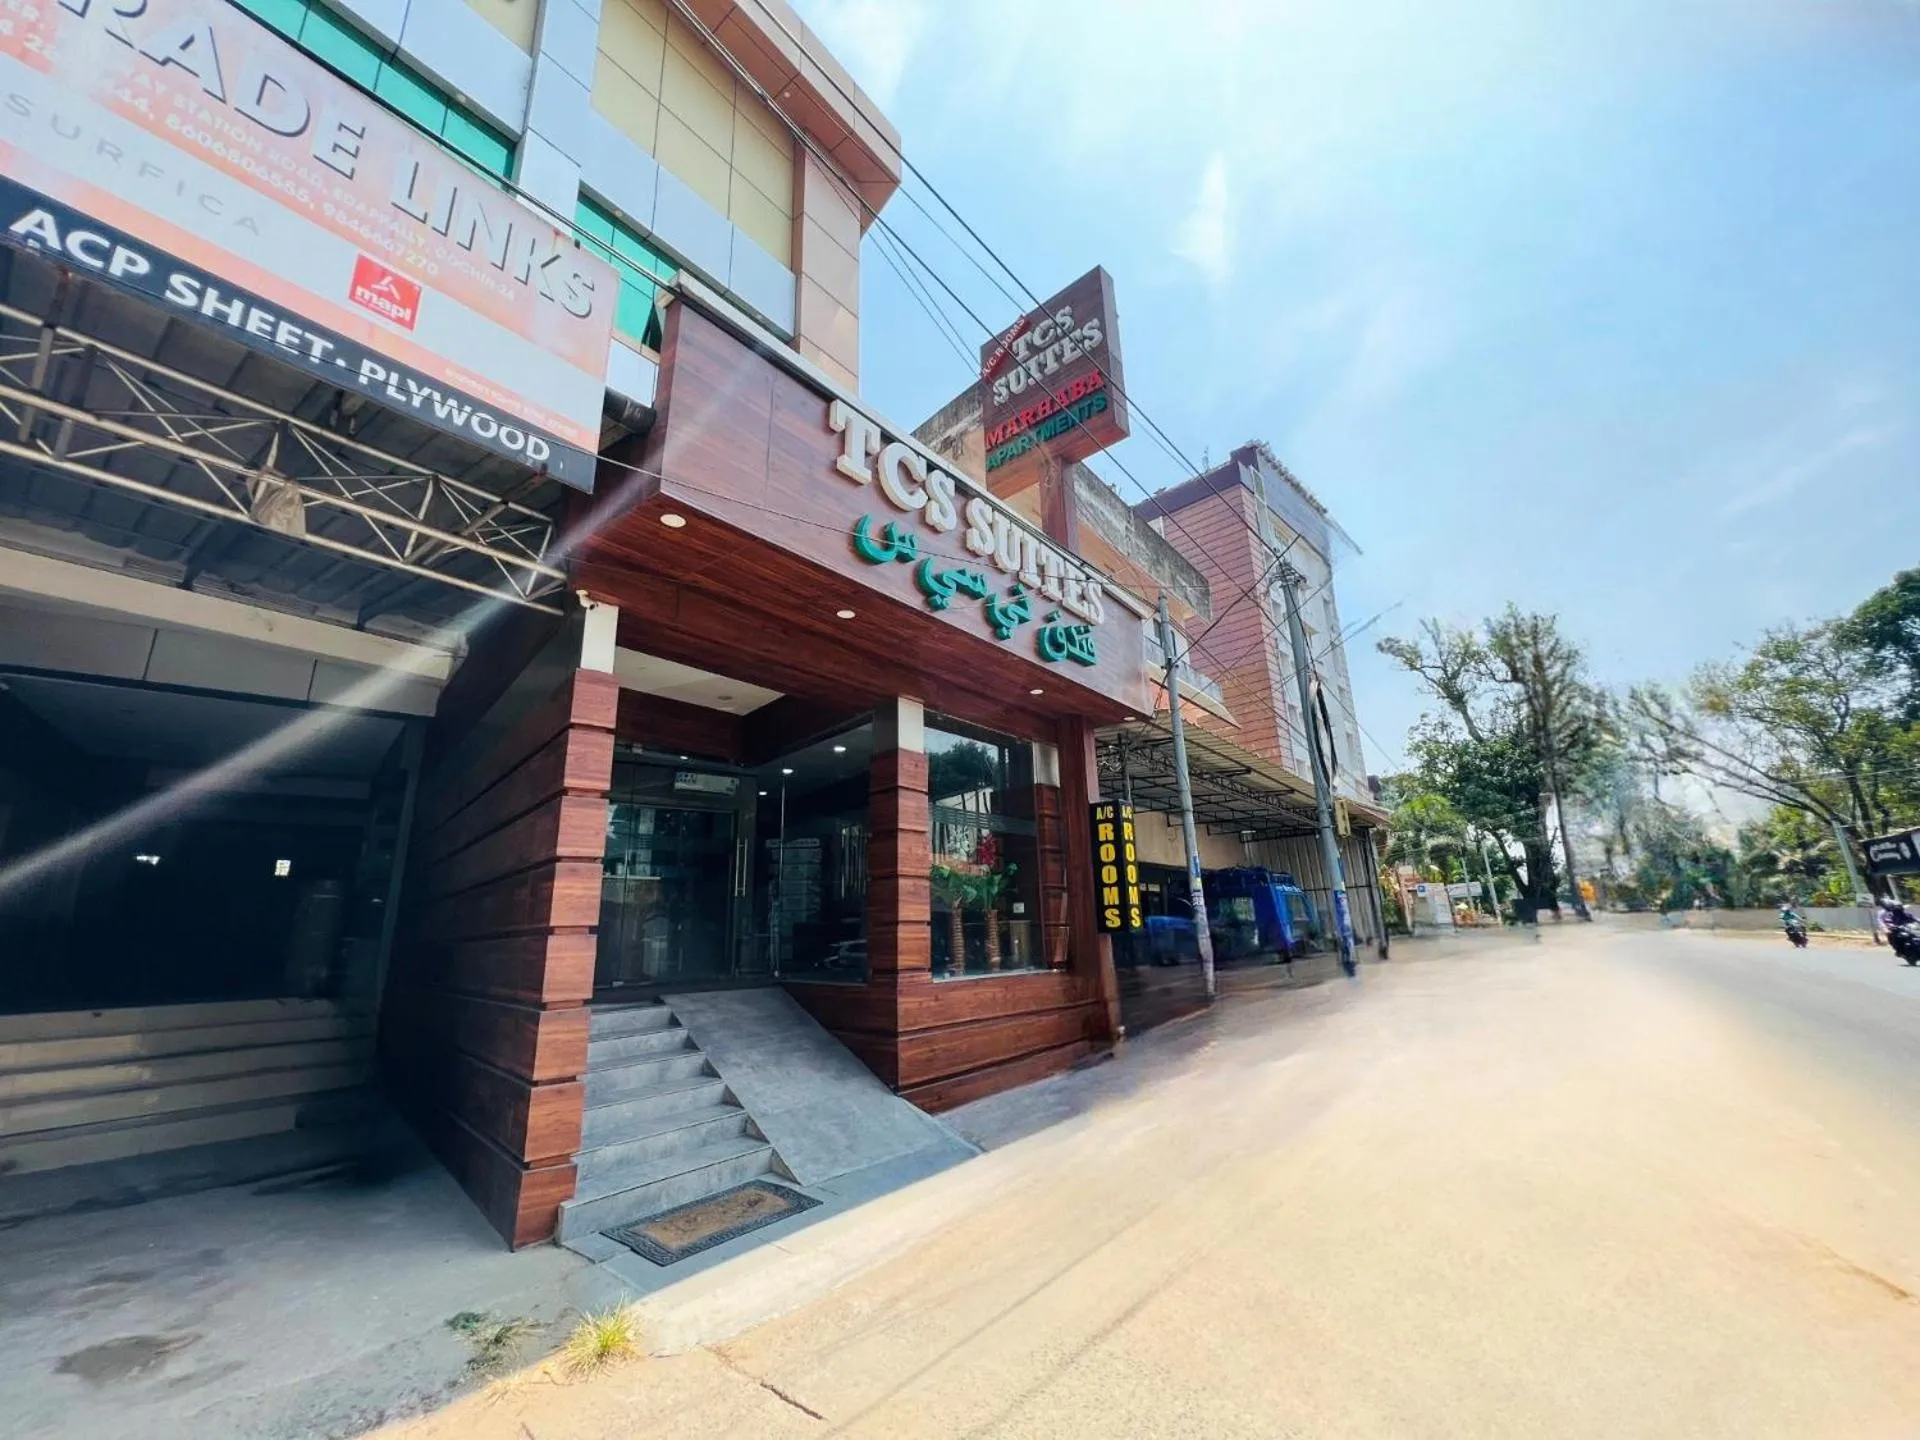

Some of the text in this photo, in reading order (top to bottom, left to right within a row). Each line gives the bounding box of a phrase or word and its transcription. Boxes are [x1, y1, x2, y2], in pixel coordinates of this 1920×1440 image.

[390, 138, 597, 319] LINKS
[9, 208, 150, 279] ACP
[358, 358, 550, 461] PLYWOOD
[993, 317, 1104, 407] SUITES
[1012, 305, 1075, 362] TCS
[986, 368, 1105, 449] MARHABA
[829, 398, 1105, 626] TCS SUITES
[1096, 805, 1121, 929] A/C ROOMS
[1123, 821, 1141, 929] ROOMS
